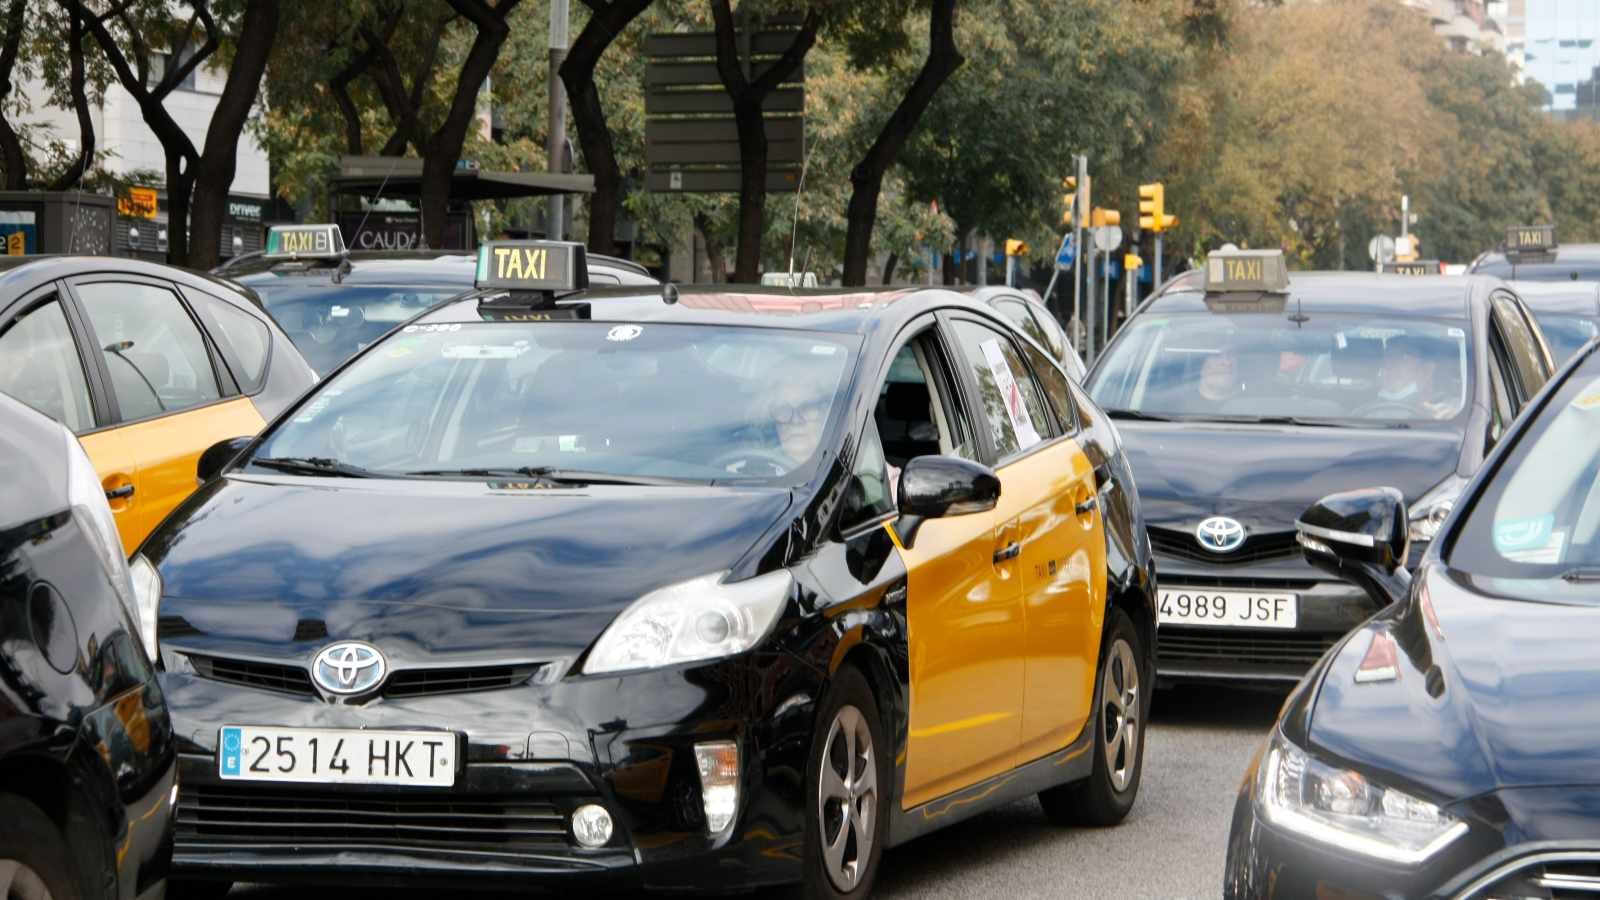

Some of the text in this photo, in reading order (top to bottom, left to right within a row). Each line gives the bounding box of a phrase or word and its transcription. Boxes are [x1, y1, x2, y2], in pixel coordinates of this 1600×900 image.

[282, 231, 313, 252] TAXI
[1518, 231, 1542, 245] TAXI
[494, 248, 547, 279] TAXI
[1226, 260, 1261, 281] TAXI
[1159, 593, 1288, 621] 4989 JSF
[227, 757, 236, 768] E
[249, 736, 444, 777] 2514 HKT
